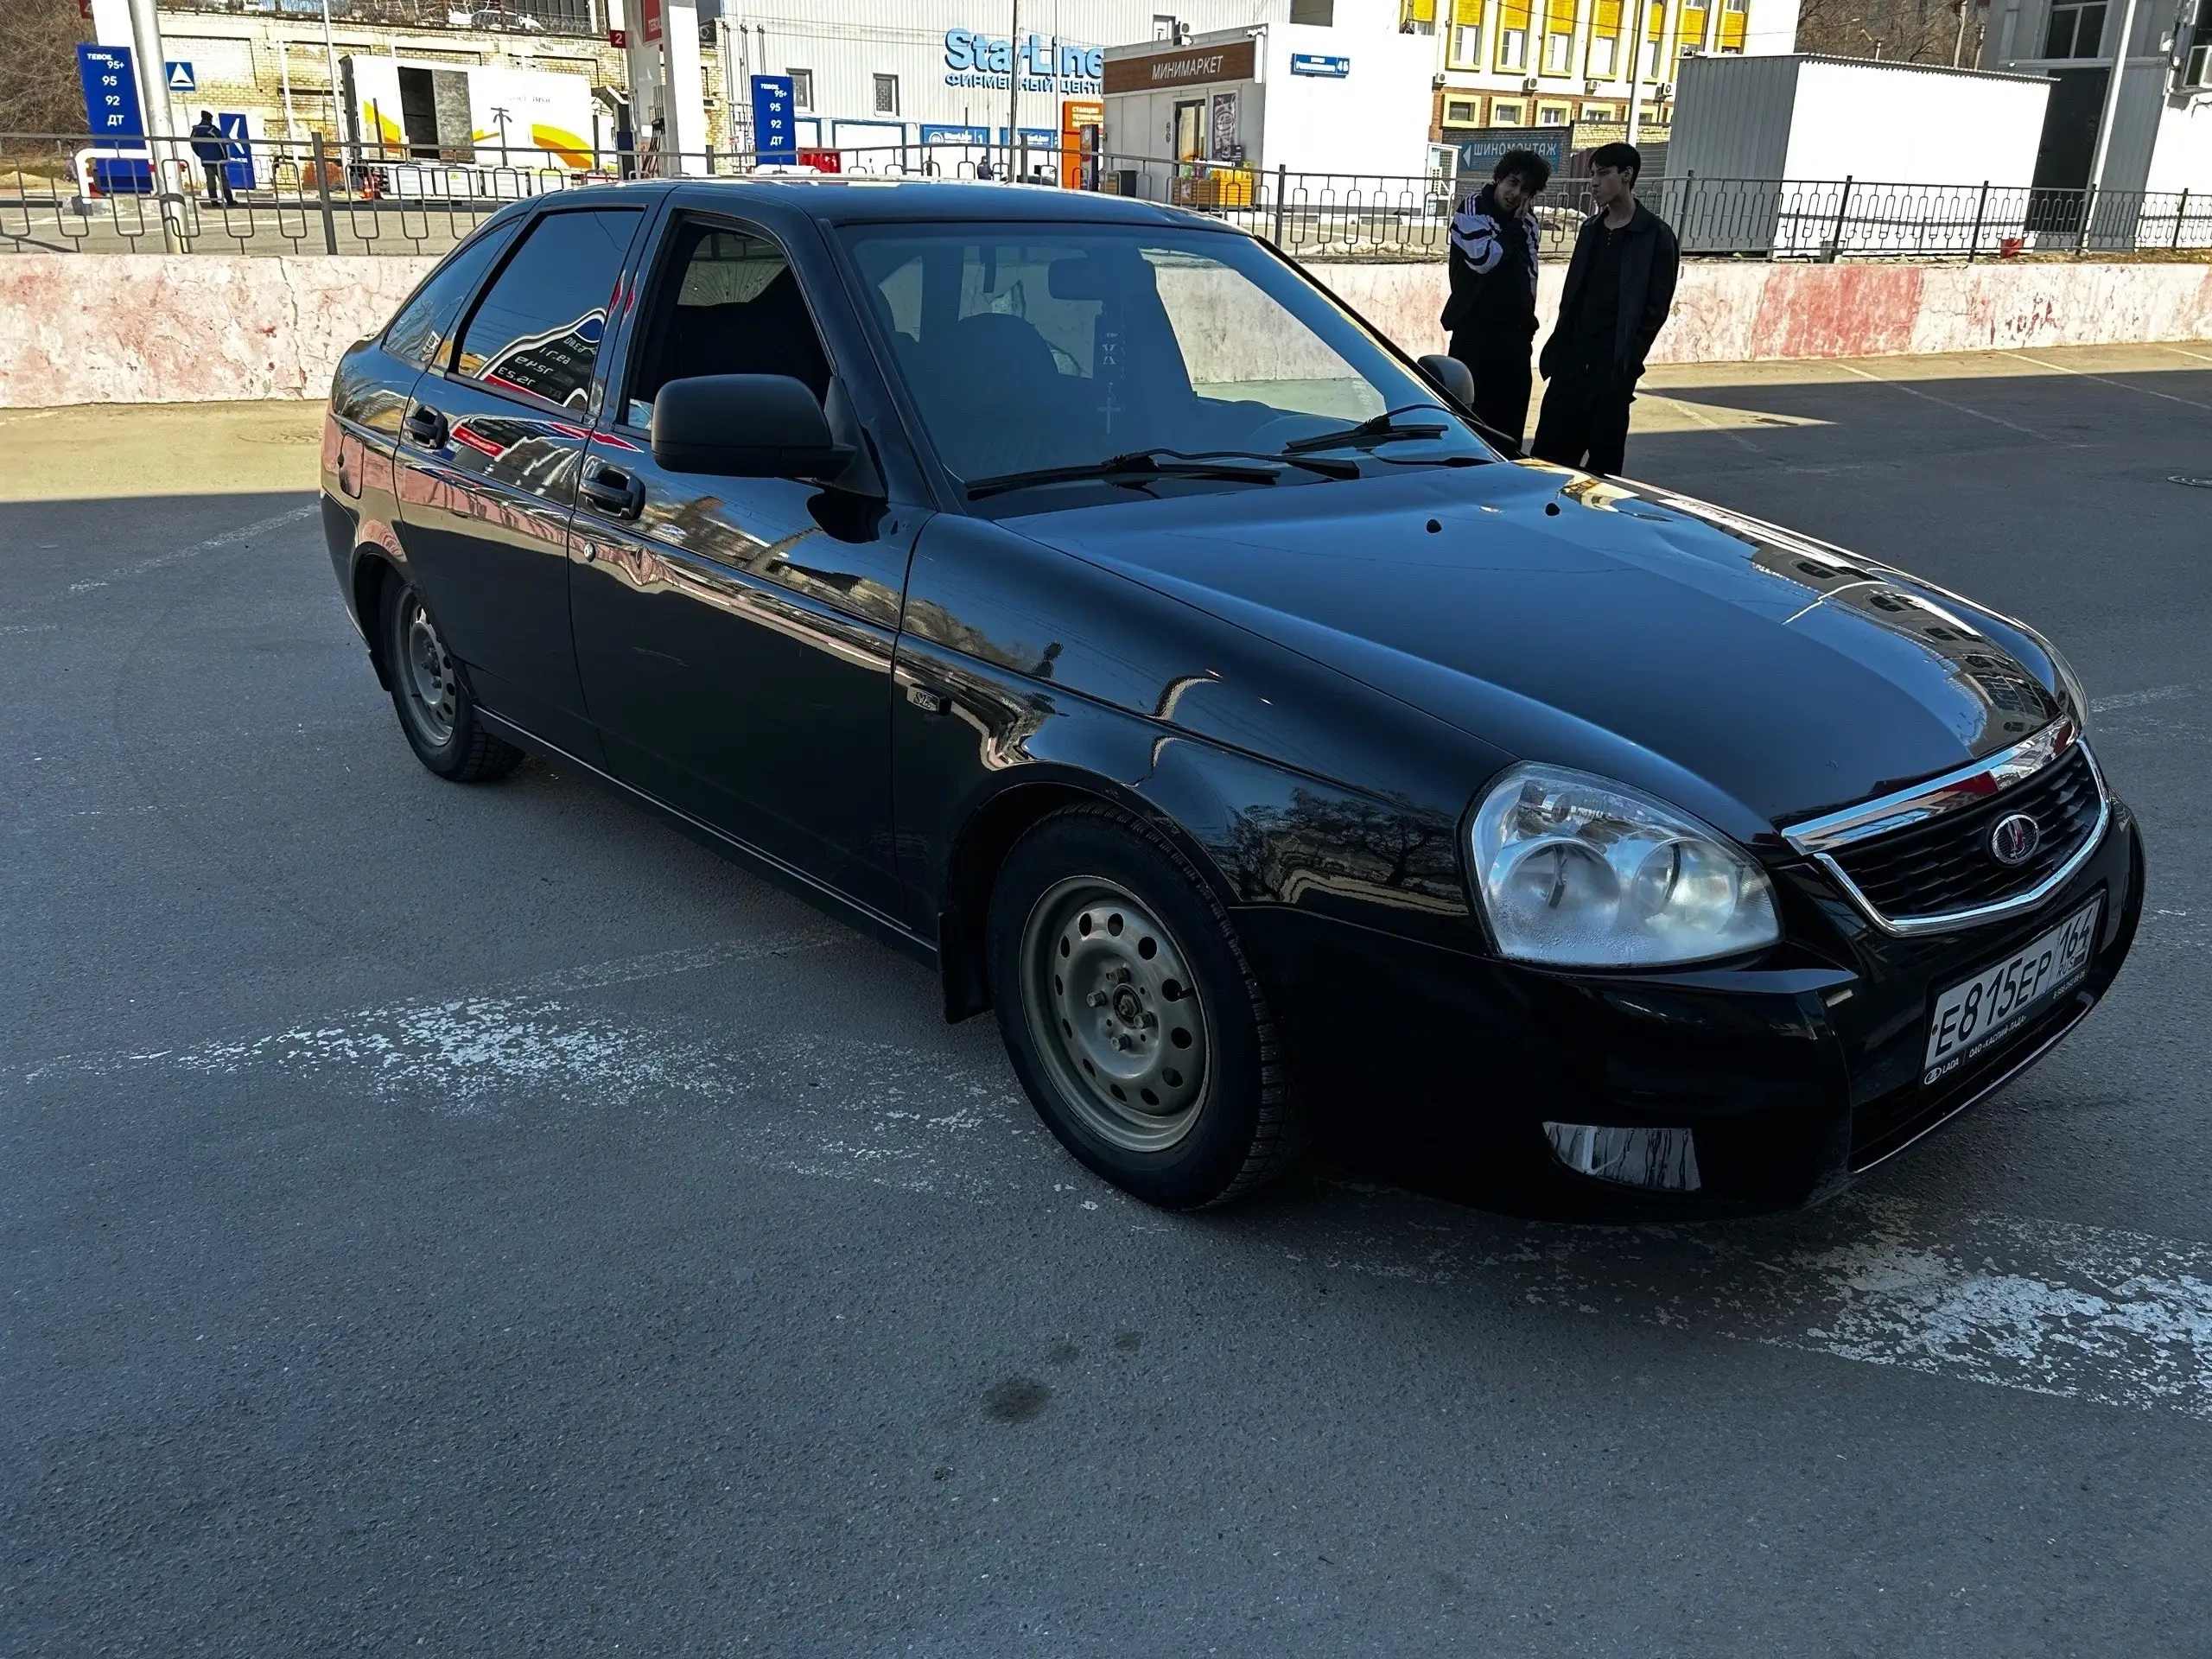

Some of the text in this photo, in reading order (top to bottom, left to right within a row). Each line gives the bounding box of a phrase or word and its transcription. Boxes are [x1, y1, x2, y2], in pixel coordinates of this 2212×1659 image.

[614, 33, 623, 44] 2
[107, 60, 124, 69] 95+
[1152, 55, 1224, 80] МИНИМАРКЕТ
[102, 75, 118, 86] 95
[105, 95, 120, 105] 92
[770, 103, 781, 111] 95
[107, 114, 124, 126] ДТ
[770, 119, 782, 129] 92
[770, 136, 784, 146] ДТ
[2060, 907, 2094, 964] 164
[2056, 956, 2075, 979] RUS
[1942, 1058, 1960, 1073] LADA
